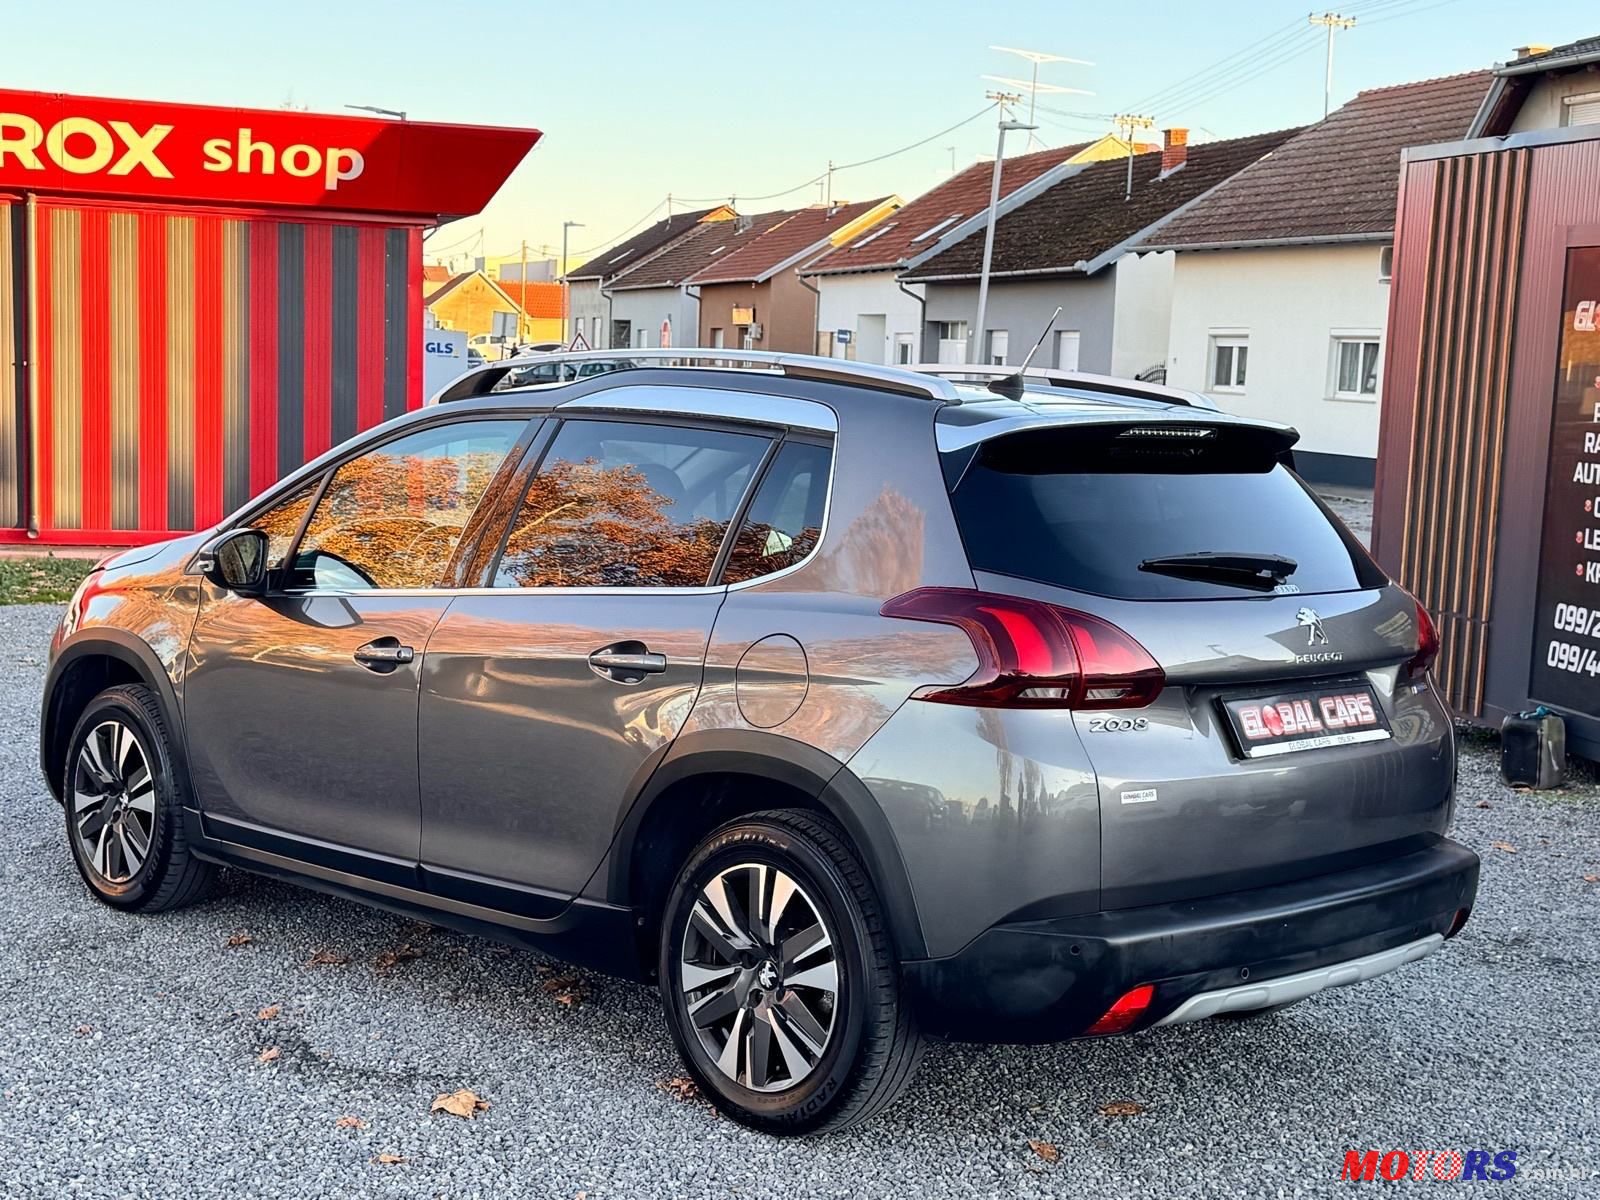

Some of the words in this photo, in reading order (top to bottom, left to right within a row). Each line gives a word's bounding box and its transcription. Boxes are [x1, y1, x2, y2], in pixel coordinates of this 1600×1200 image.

[203, 128, 365, 190] shop
[426, 342, 453, 354] GLS
[1554, 602, 1600, 638] 099/2
[1296, 651, 1344, 664] PEUGEOT
[1238, 699, 1323, 739] GLOBAL
[1319, 692, 1378, 728] CARS
[1089, 717, 1149, 733] 2008
[1288, 739, 1313, 750] GLOBAL
[1313, 737, 1332, 746] CARS
